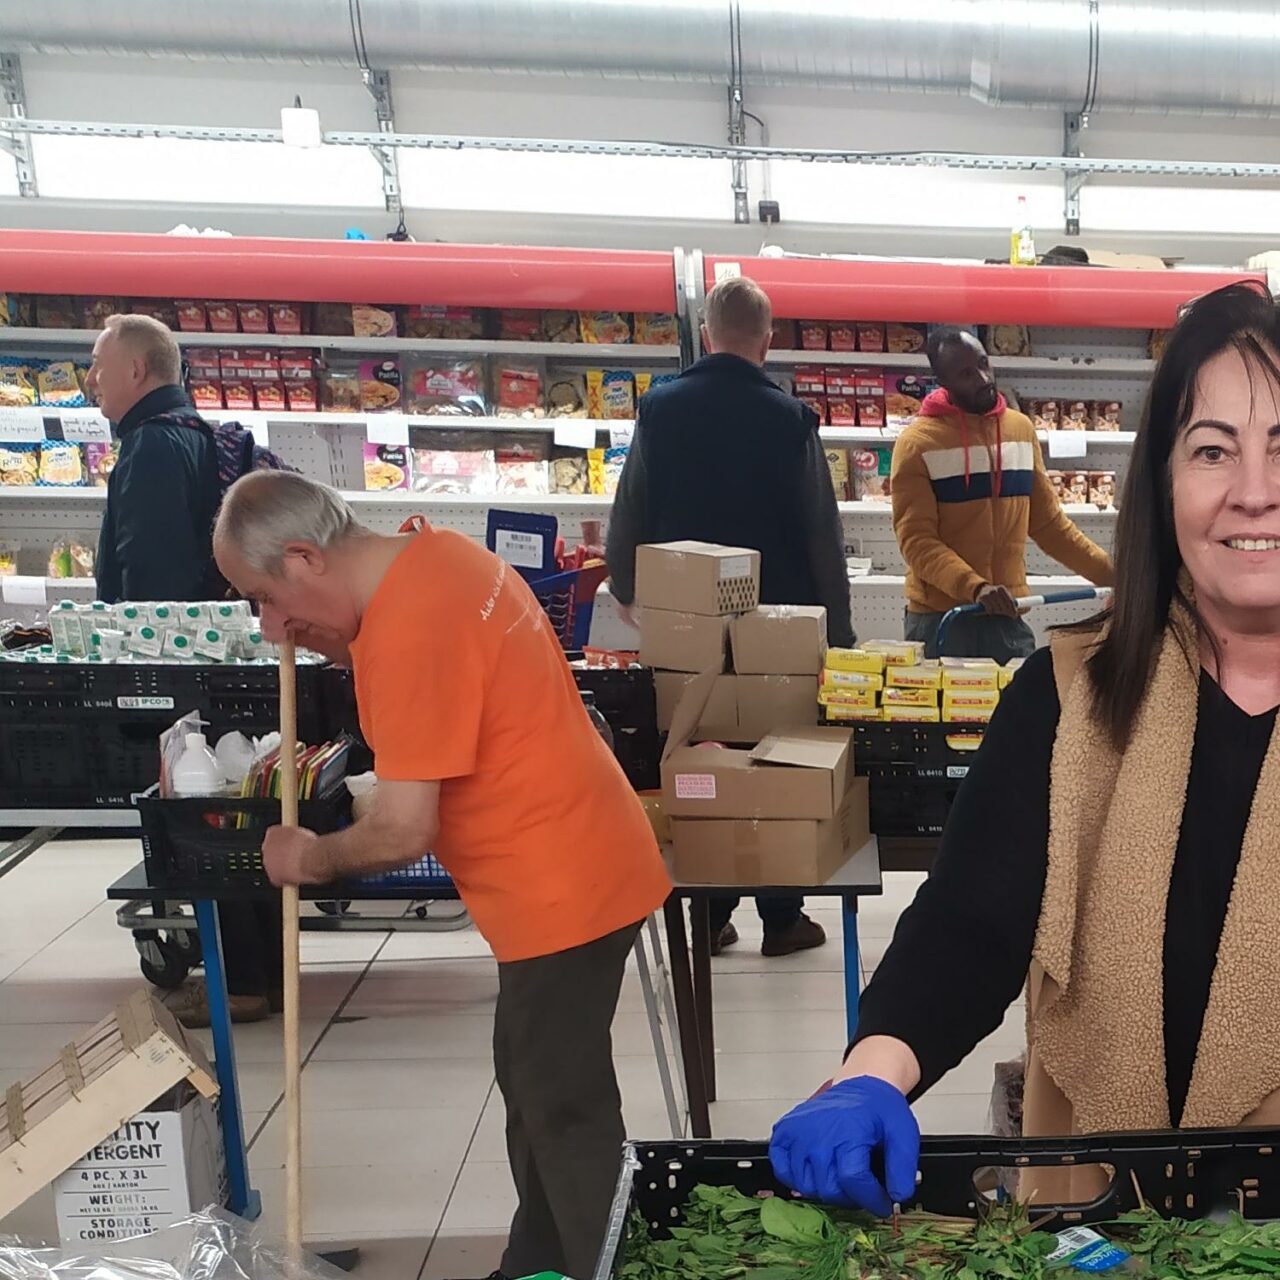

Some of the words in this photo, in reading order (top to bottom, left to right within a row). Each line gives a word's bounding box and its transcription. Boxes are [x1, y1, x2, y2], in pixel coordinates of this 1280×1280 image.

[81, 1171, 89, 1181] 4
[94, 1170, 115, 1181] PC.
[119, 1169, 128, 1180] X
[132, 1169, 148, 1180] 3L
[89, 1194, 147, 1206] WEIGHT:
[91, 1216, 152, 1229] STORAGE
